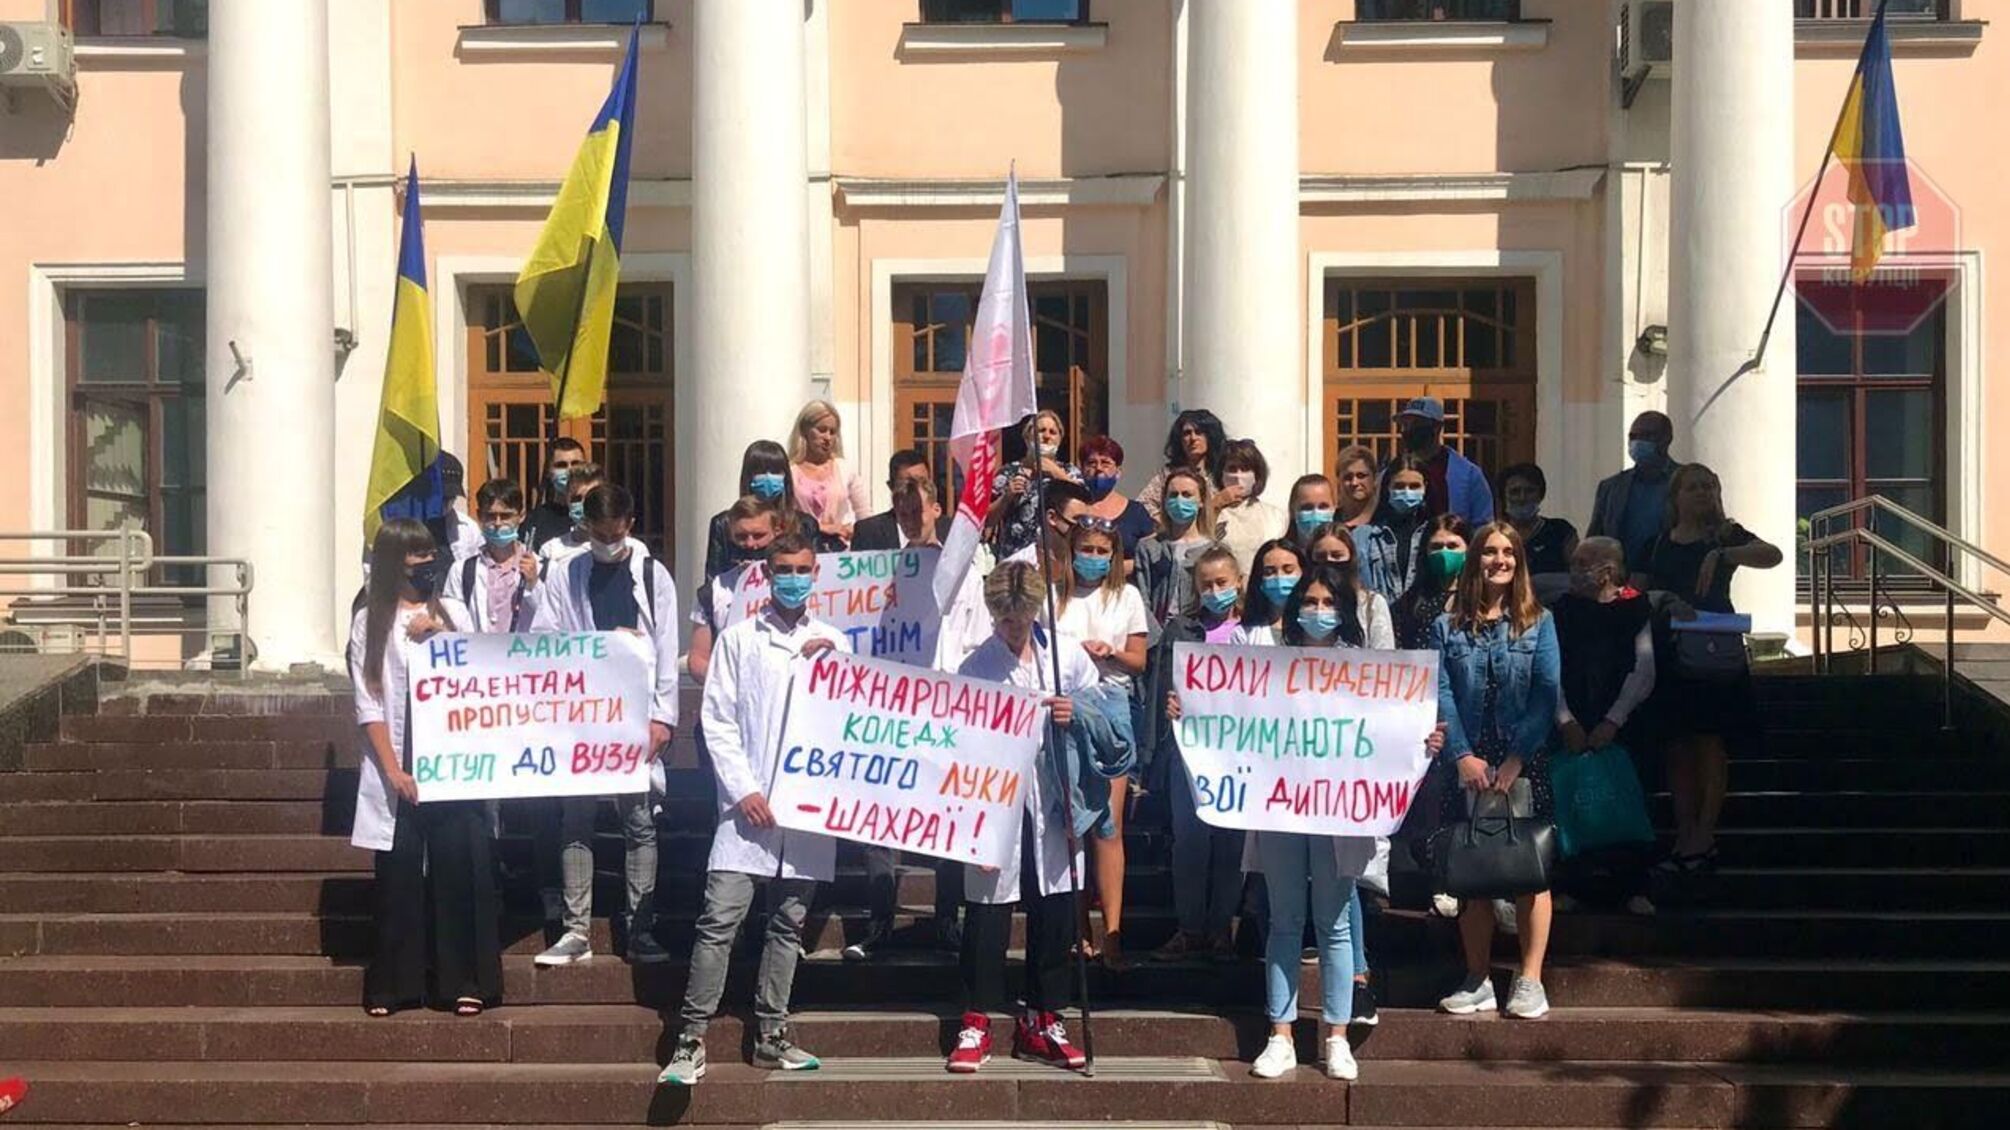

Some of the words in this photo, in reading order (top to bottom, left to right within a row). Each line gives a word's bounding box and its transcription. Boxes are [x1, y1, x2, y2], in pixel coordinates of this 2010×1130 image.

[837, 552, 920, 579] ЗМОГУ
[429, 639, 468, 669] НЕ
[507, 633, 609, 659] ДАЙТЕ
[416, 670, 586, 702] СТУДЕНТАМ
[1185, 653, 1271, 698] КОЛИ
[1285, 656, 1431, 703] СТУДЕНТИ
[448, 697, 624, 732] ПРОПУСТИТИ
[843, 712, 960, 749] КОЛЕДЖ
[1181, 714, 1375, 760] ОТРИМАЮТЬ
[416, 753, 497, 783] ВСТУП
[512, 747, 556, 776] ДО
[571, 742, 643, 774] ВУЗУ
[783, 746, 920, 790] СВЯТОГО
[939, 761, 1020, 807] ЛУКИ
[1197, 766, 1252, 813] ВОЇ
